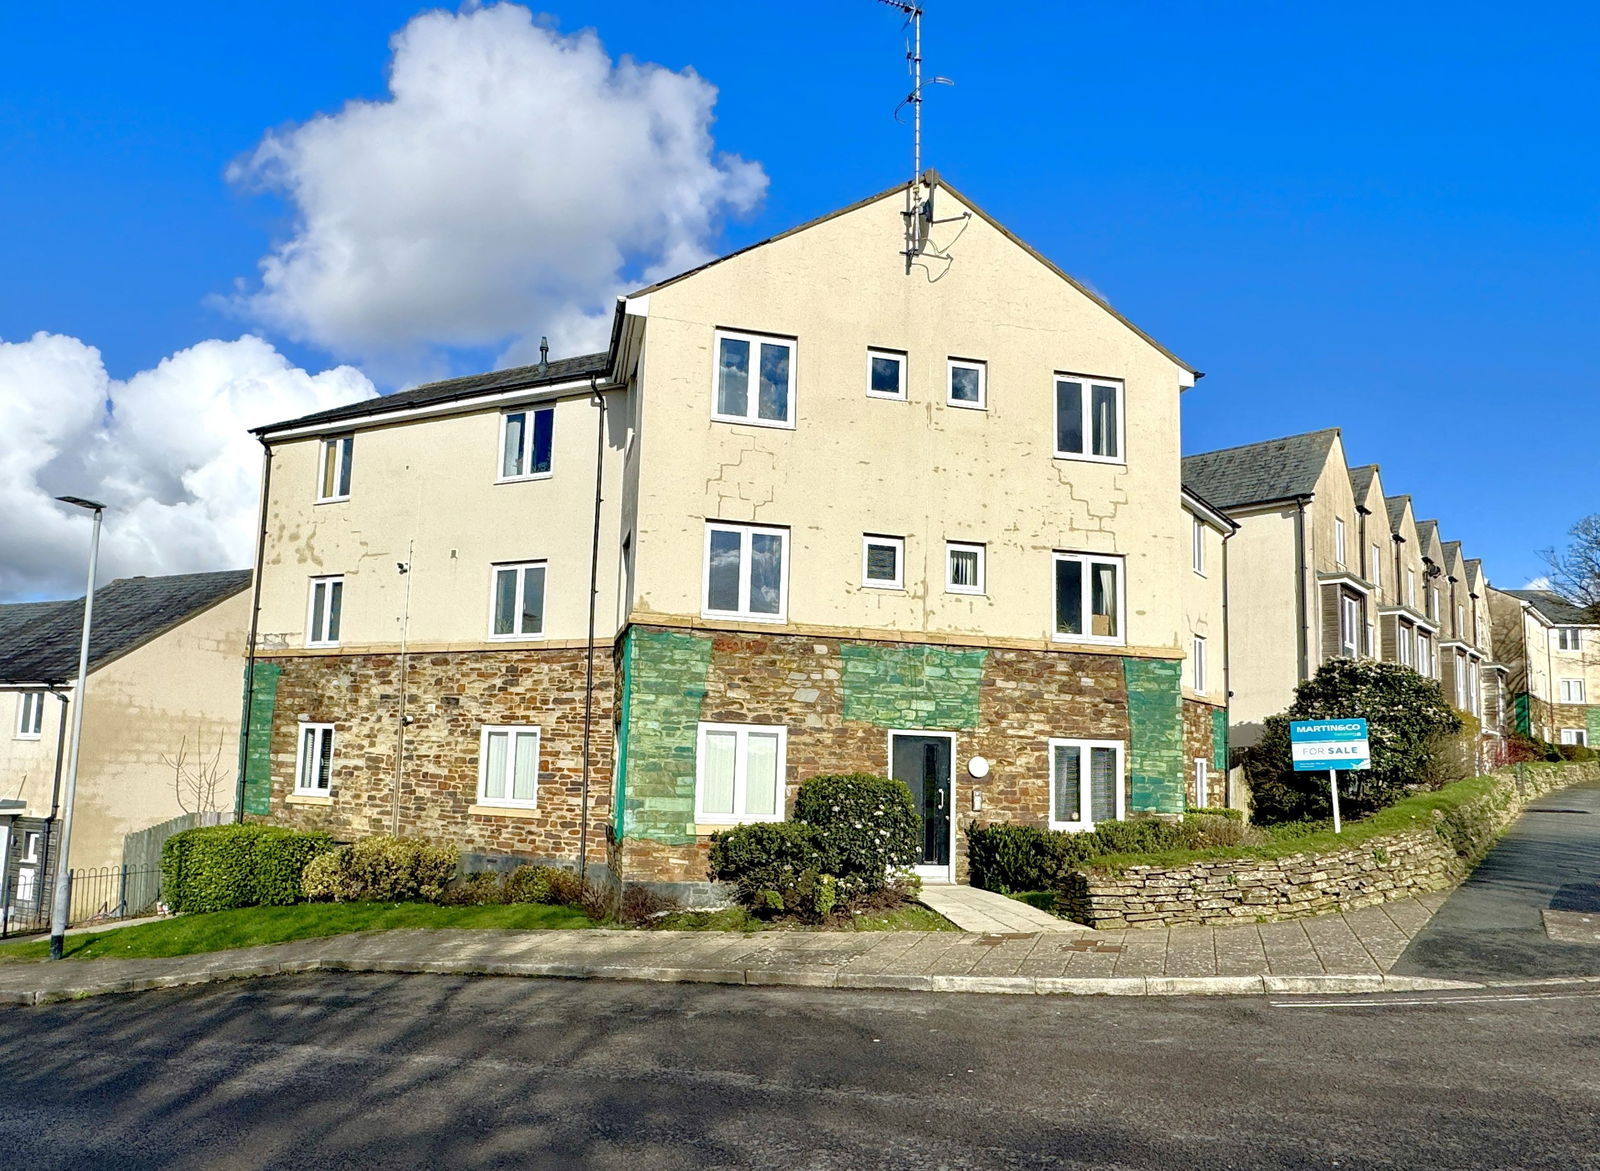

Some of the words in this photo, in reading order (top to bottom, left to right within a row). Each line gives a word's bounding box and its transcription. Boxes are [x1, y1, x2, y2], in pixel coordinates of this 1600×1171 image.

[1296, 724, 1361, 733] MARTIN&CO
[1303, 747, 1325, 755] FOR
[1328, 747, 1358, 755] SALE
